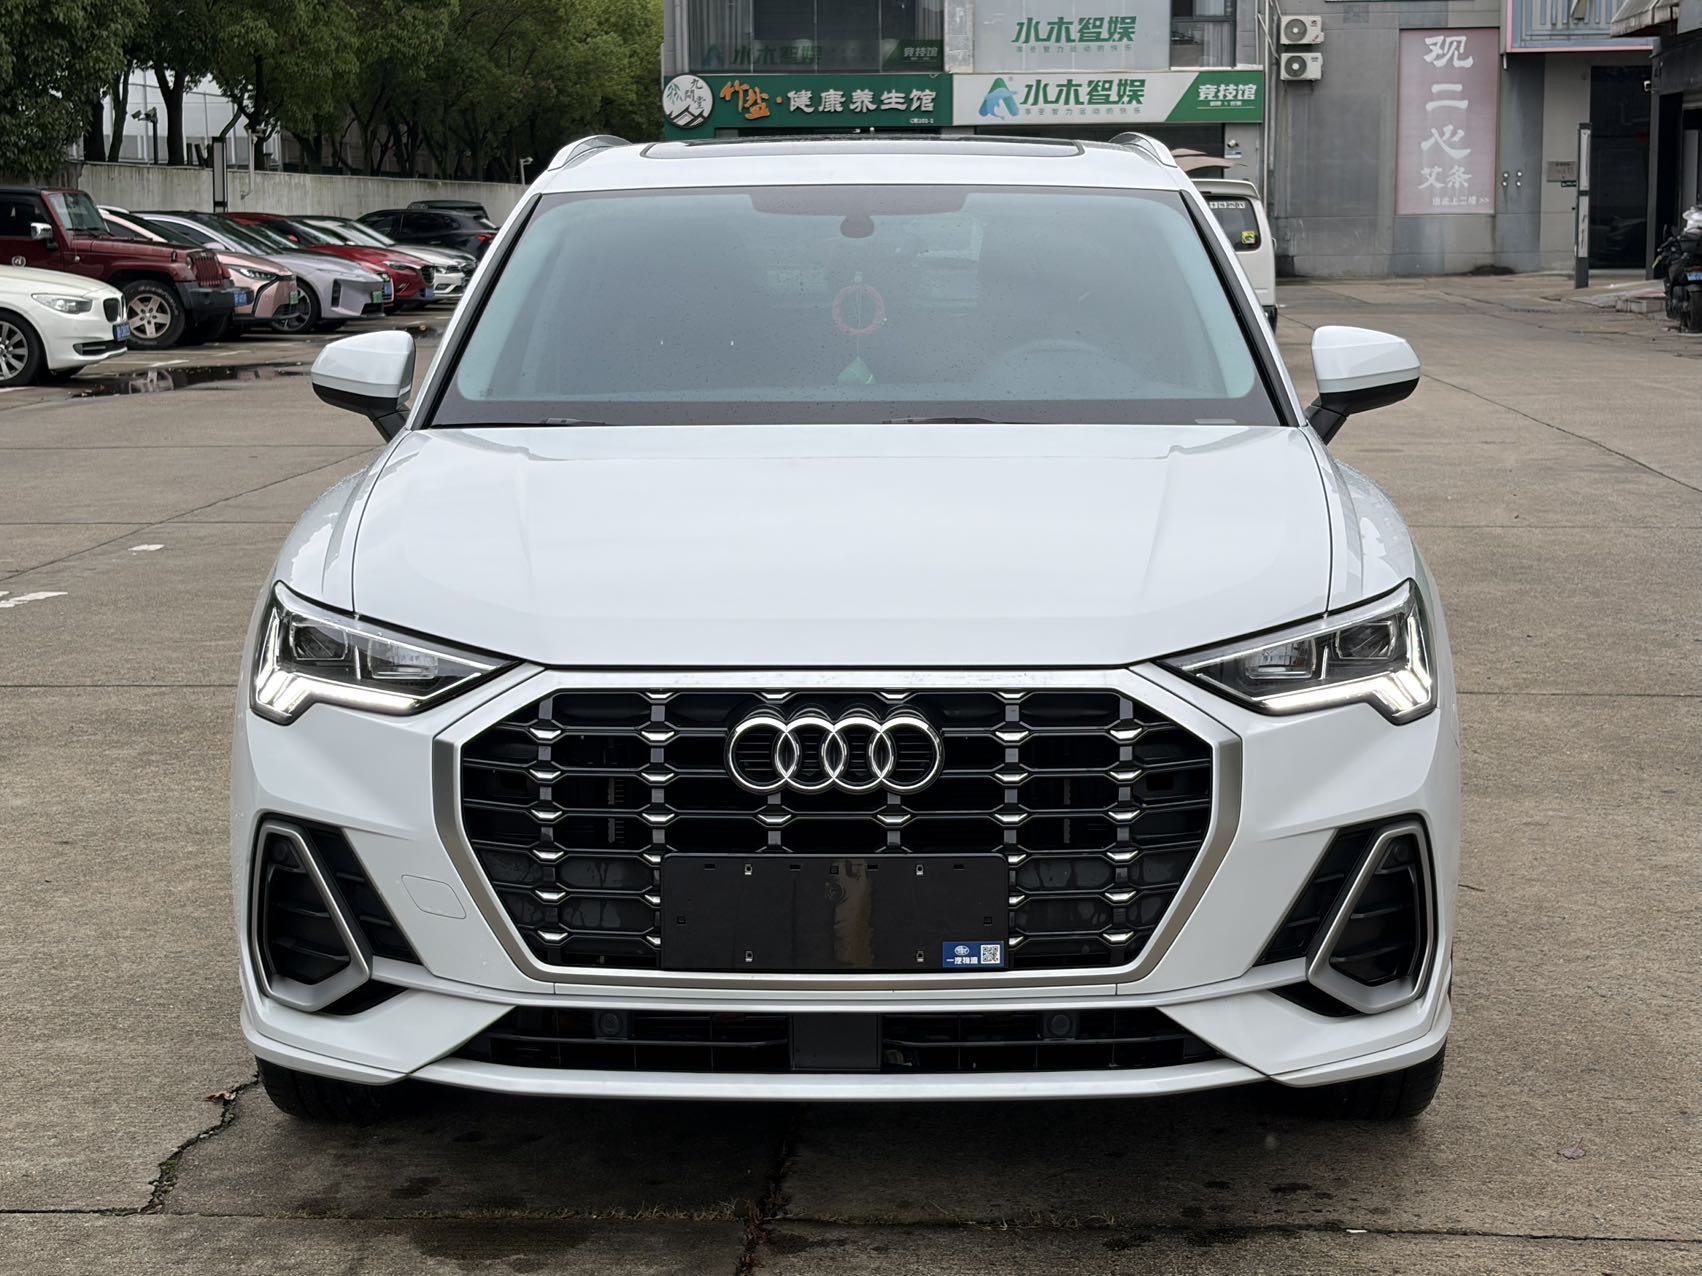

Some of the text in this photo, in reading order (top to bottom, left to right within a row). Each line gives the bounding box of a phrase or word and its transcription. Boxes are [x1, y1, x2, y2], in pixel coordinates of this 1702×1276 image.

[1011, 16, 1137, 44] 水木智娱
[1020, 79, 1147, 106] 水木智娱
[1198, 83, 1257, 101] 竞技馆
[1420, 34, 1474, 160] 观二心
[1417, 164, 1473, 189] 艾条
